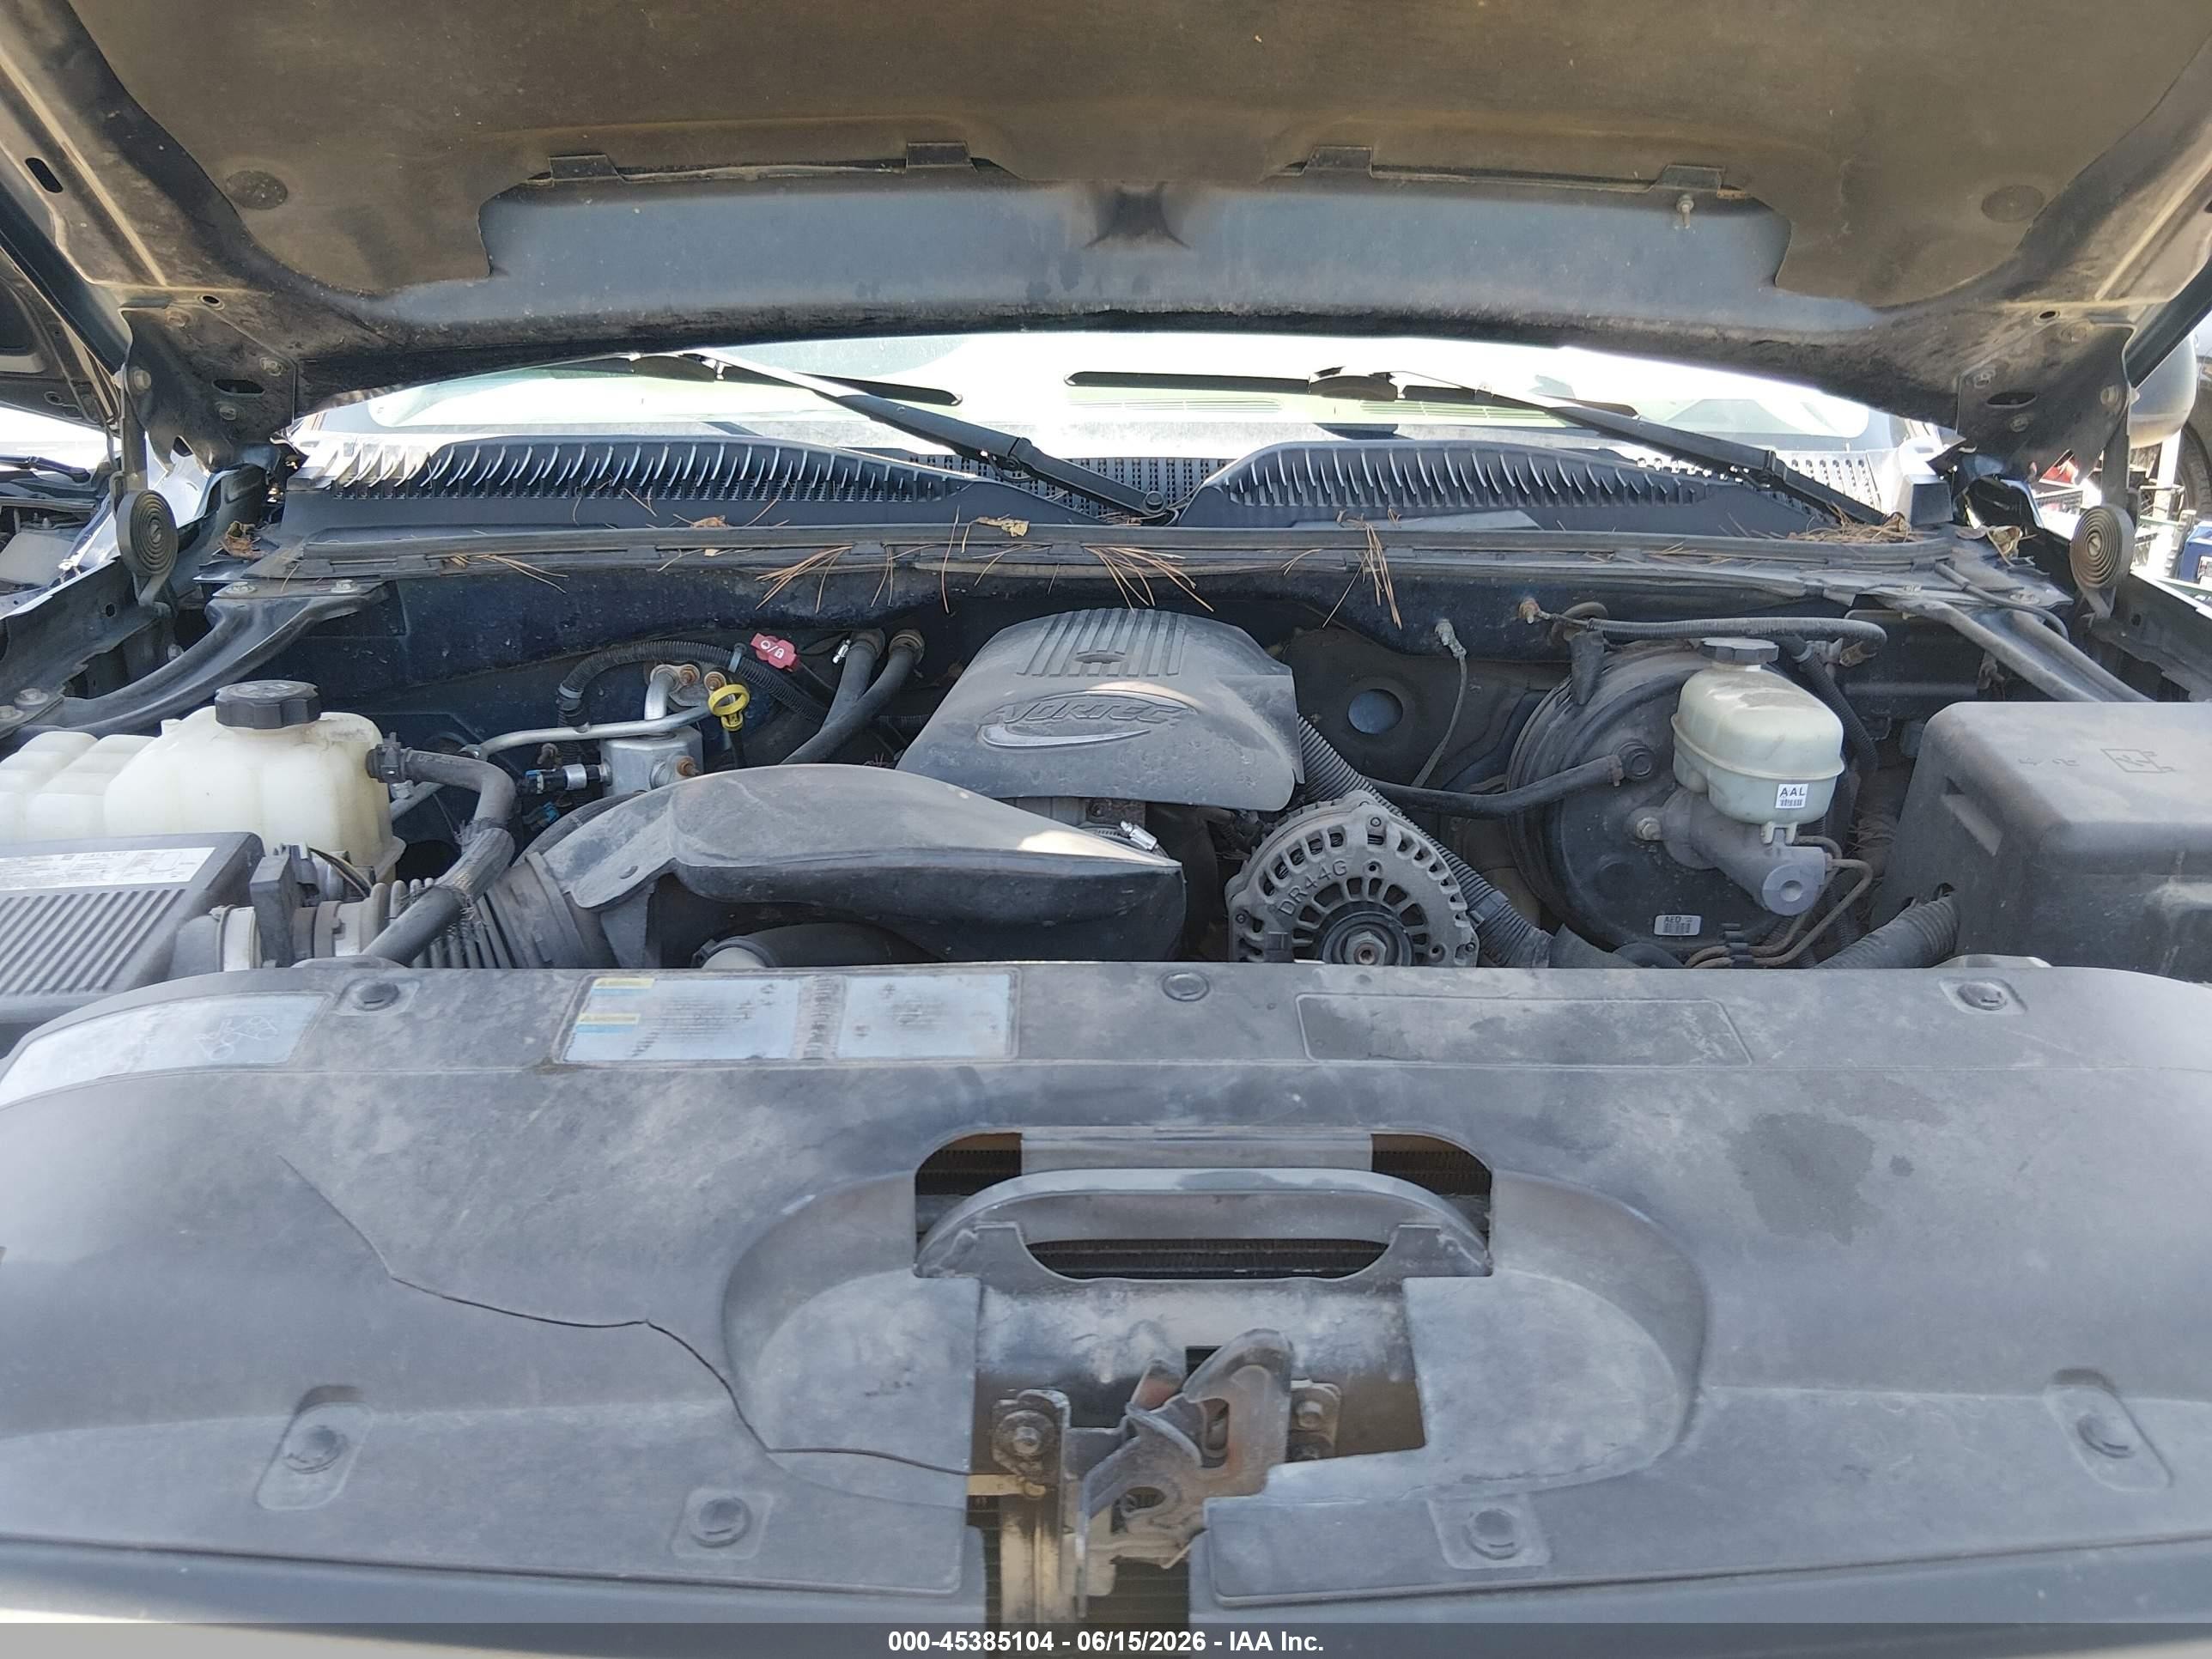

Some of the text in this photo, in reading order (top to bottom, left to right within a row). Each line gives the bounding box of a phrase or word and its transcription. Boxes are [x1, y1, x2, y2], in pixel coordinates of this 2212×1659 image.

[985, 700, 1187, 725] VORTEC
[1780, 787, 1805, 797] AAL
[1278, 860, 1347, 916] DR44G
